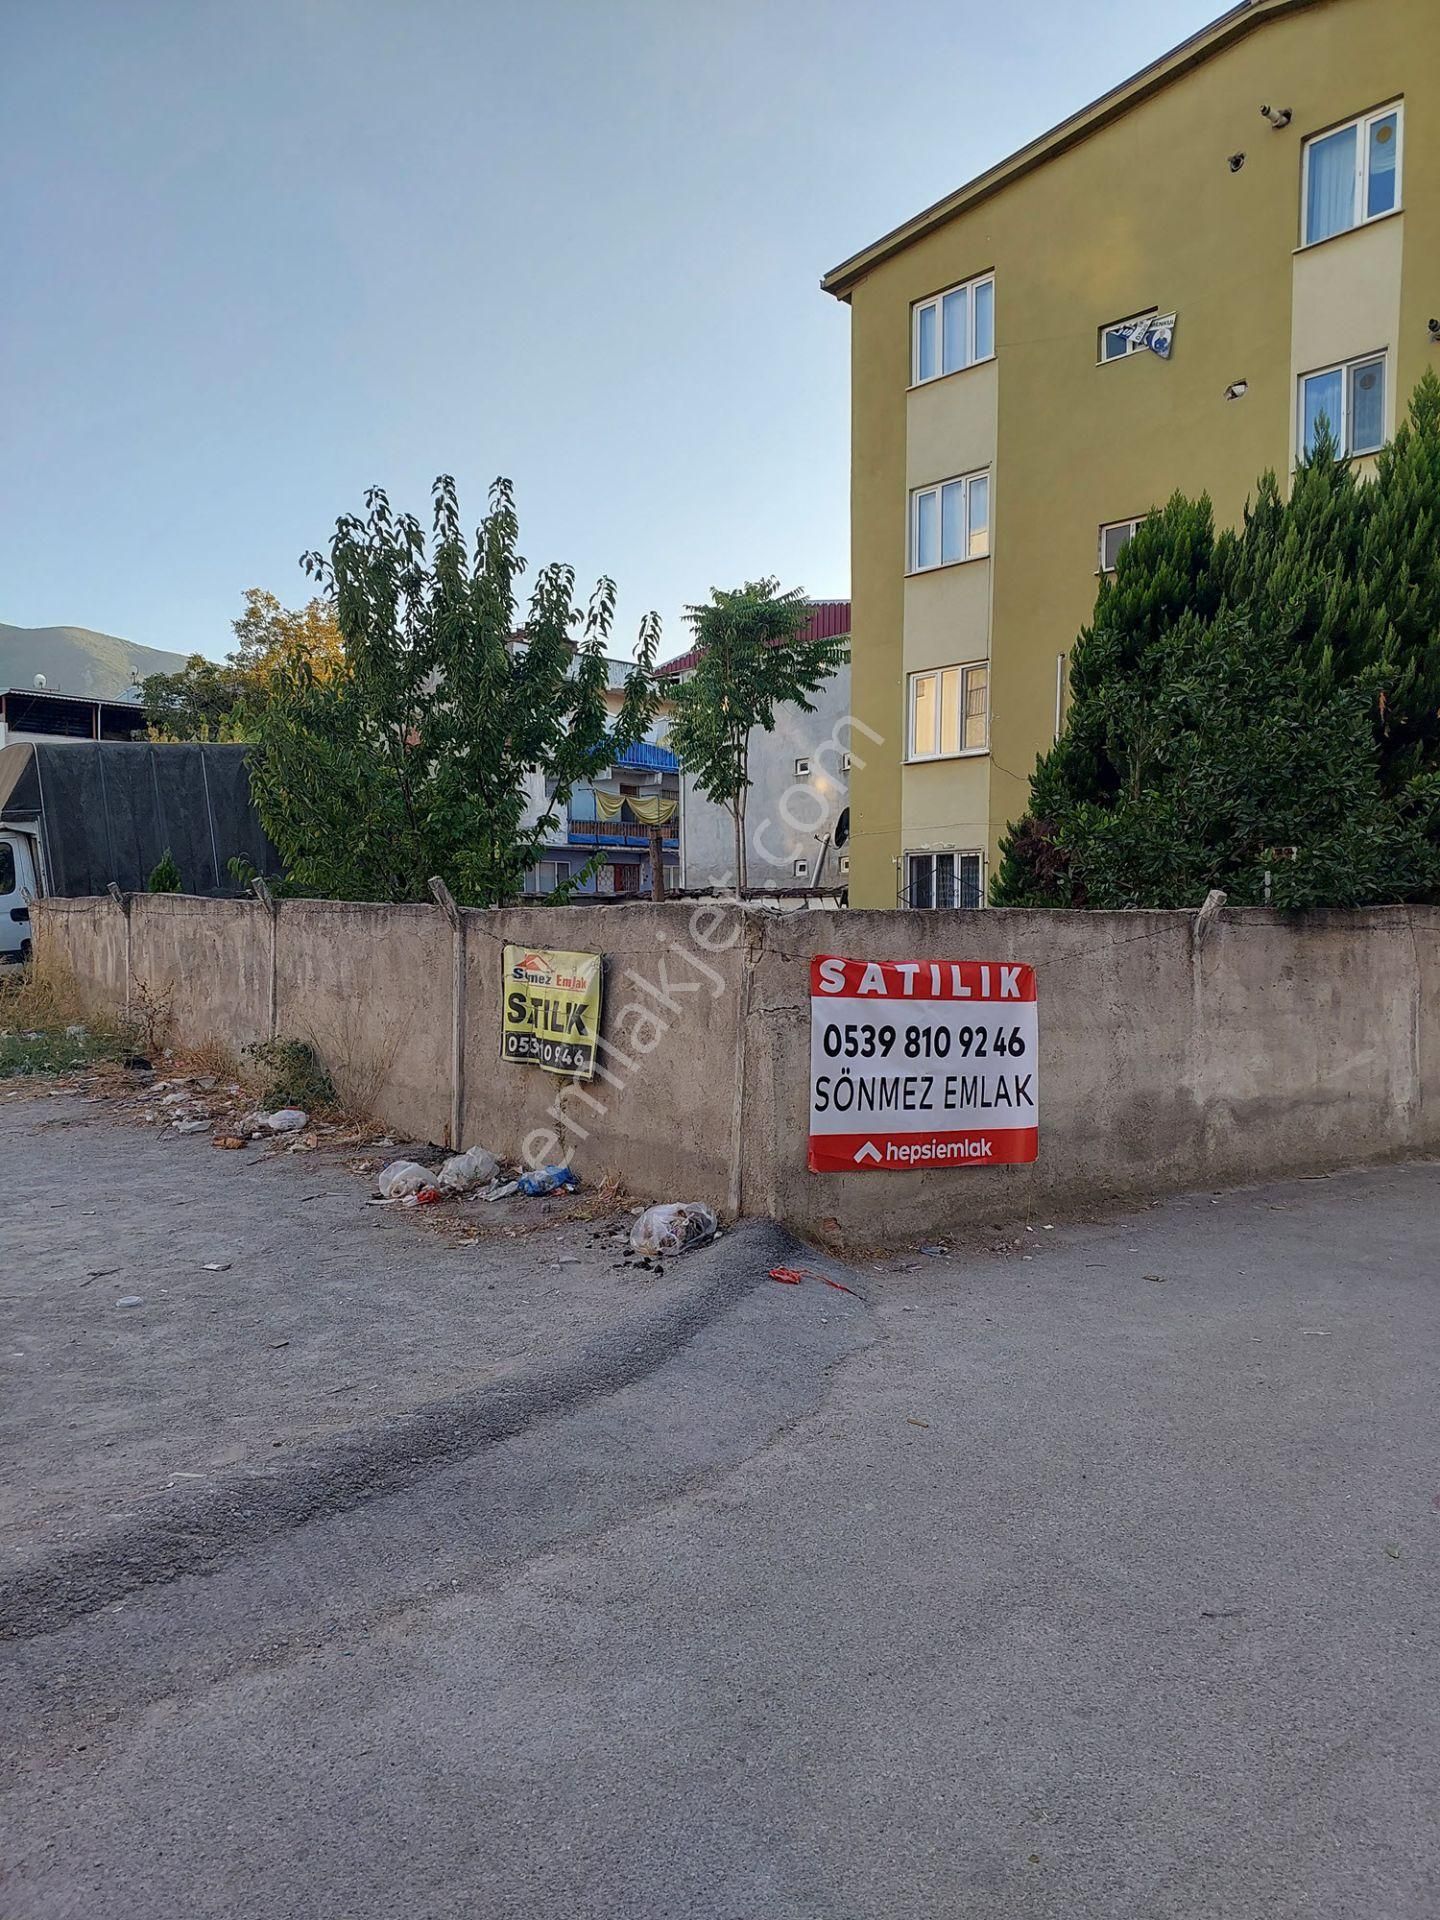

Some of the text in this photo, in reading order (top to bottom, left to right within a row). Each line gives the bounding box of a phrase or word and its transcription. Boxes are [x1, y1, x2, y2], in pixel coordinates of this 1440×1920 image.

[818, 959, 1023, 998] SATILIK
[823, 1024, 897, 1058] 0539
[904, 1025, 951, 1058] 810
[814, 1067, 1034, 1112] SÖNMEZ EMLAK
[886, 1137, 993, 1164] hepsiemlak
